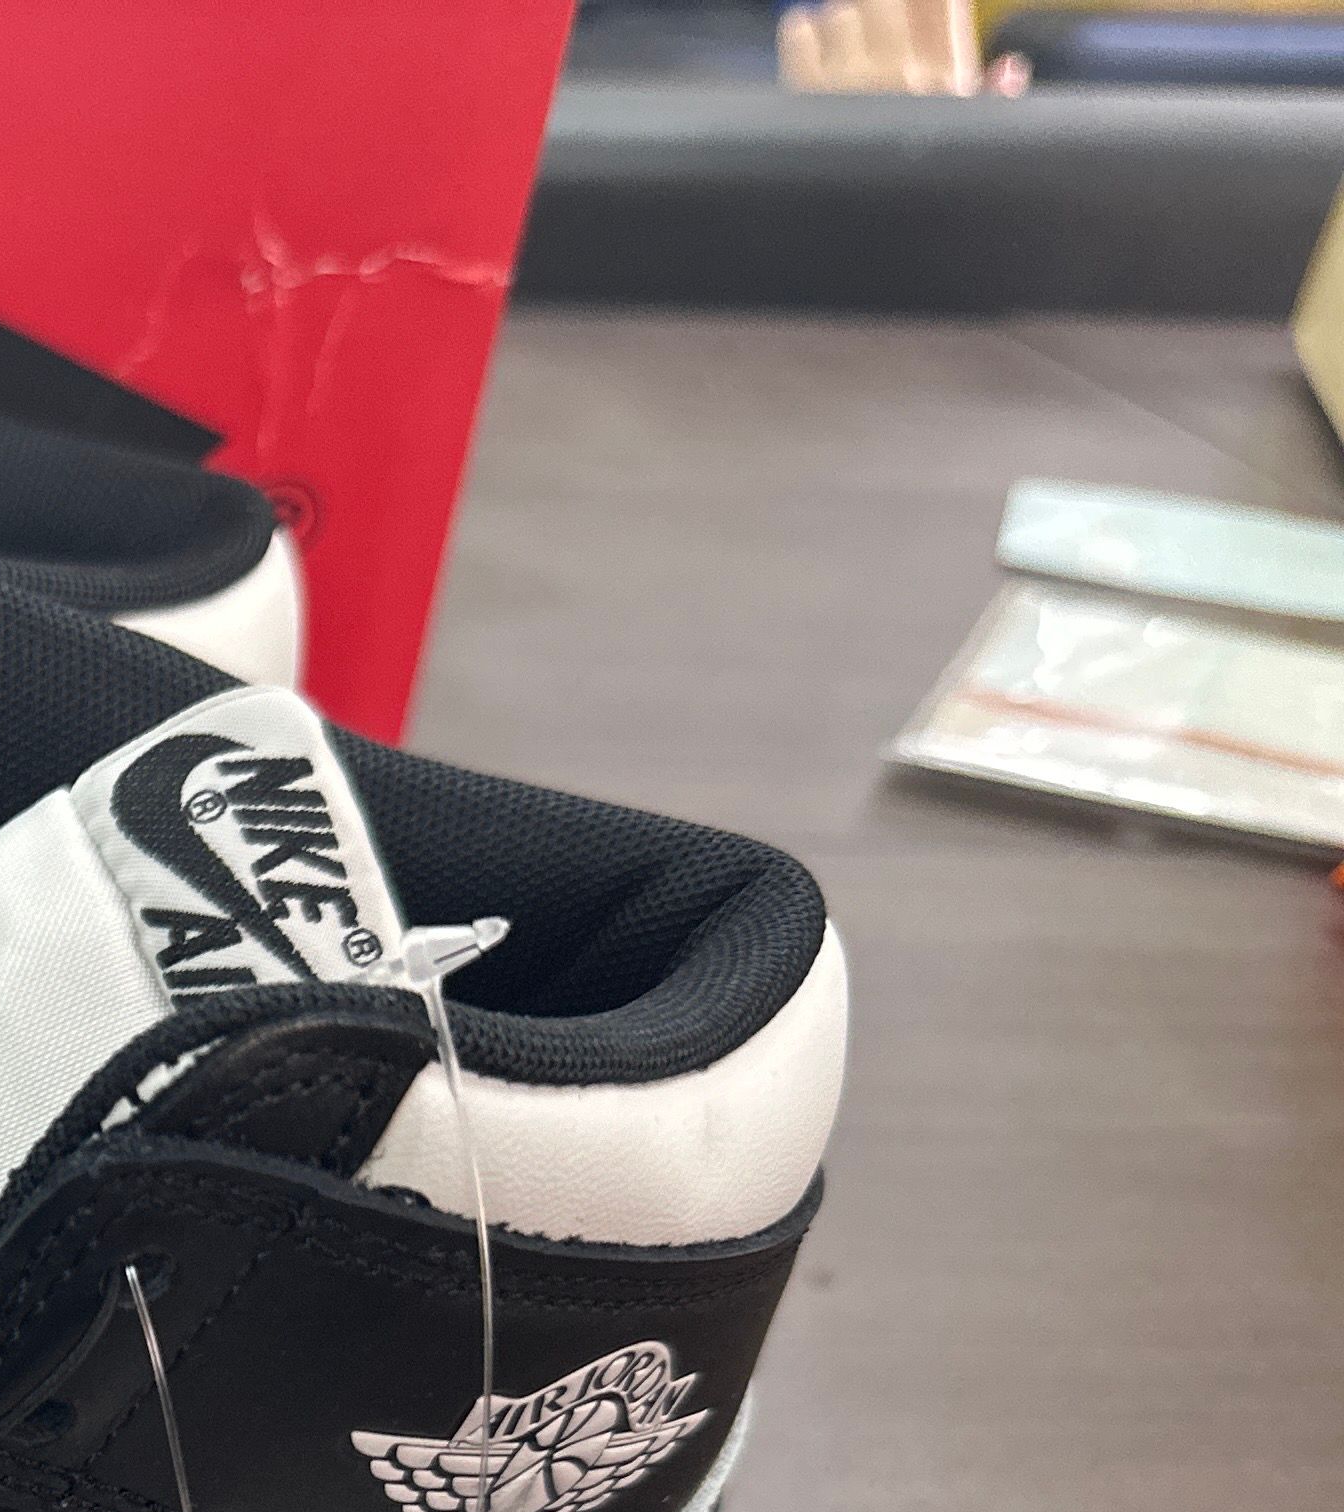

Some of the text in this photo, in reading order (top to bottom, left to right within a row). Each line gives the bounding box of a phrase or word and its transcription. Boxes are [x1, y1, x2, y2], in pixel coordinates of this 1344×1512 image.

[213, 756, 359, 928] NIKE
[139, 906, 258, 1012] AI
[467, 1350, 687, 1440] AIR JORDAN
